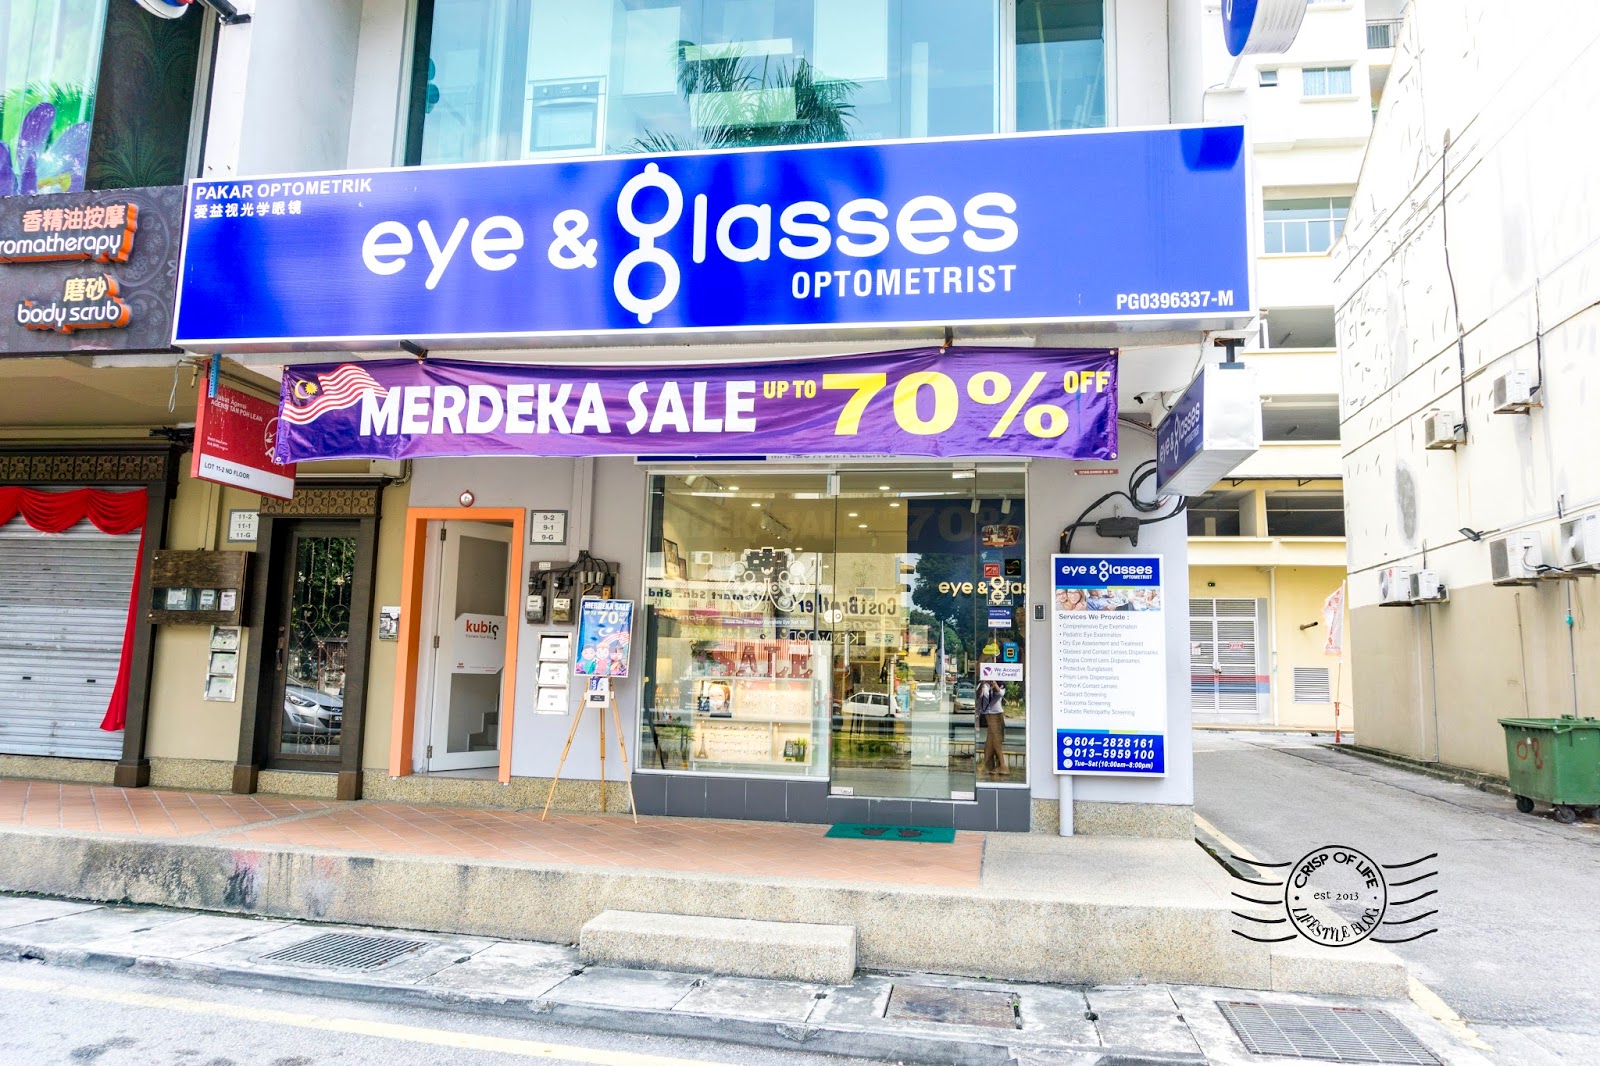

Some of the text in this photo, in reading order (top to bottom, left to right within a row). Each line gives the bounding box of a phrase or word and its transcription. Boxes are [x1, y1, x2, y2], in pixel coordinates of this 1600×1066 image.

[196, 178, 372, 200] PAKAR OPTOMETRIK
[23, 205, 125, 232] 香精油按摩
[194, 200, 301, 219] 爱益视光学眼镜
[362, 162, 1019, 324] eye & glasses
[64, 276, 106, 302] 磨砂
[792, 264, 1017, 299] OPTOMETRIST
[1117, 290, 1233, 309] PG0396337-M
[18, 301, 119, 326] body scrub
[359, 371, 1111, 438] MERDEKA SALE UP TO 70% OFF
[233, 470, 249, 479] FLOOR
[1062, 560, 1153, 582] eye & glasses
[938, 582, 973, 597] eye
[977, 582, 988, 594] &
[711, 646, 813, 678] SALE
[1133, 739, 1154, 748] 161
[1133, 750, 1154, 759] 100
